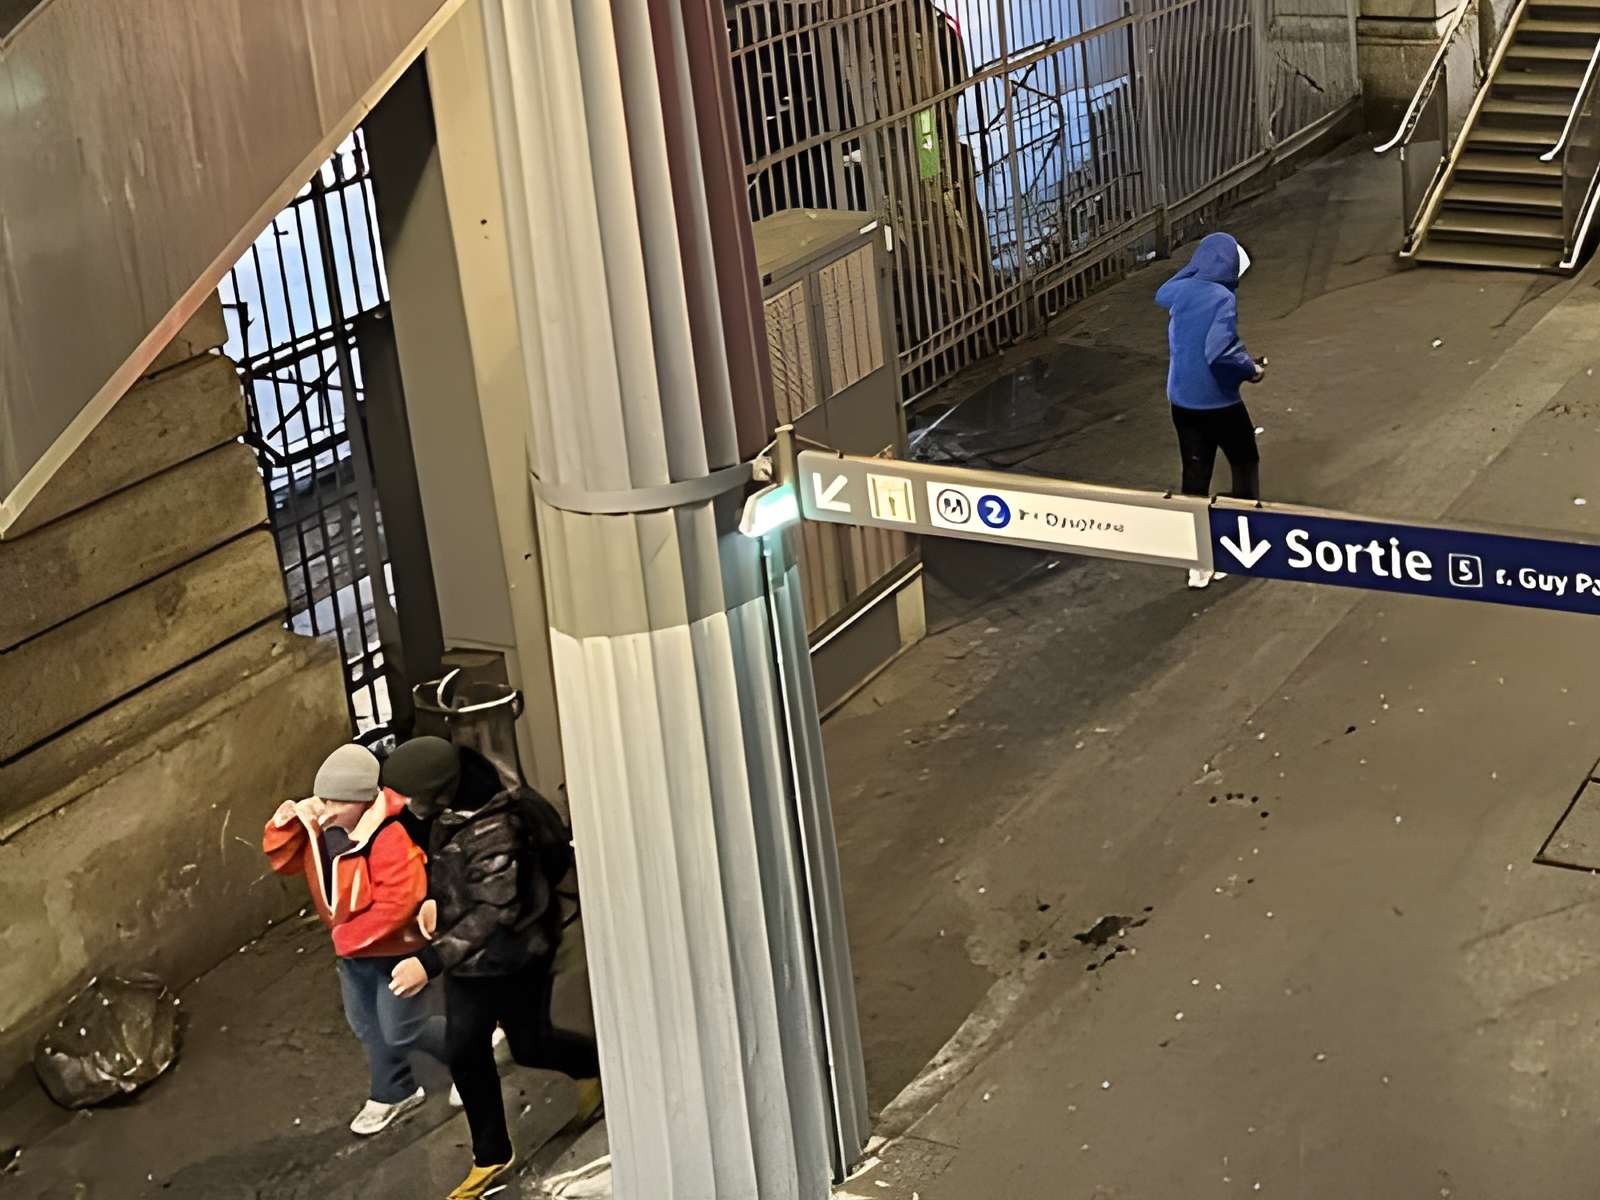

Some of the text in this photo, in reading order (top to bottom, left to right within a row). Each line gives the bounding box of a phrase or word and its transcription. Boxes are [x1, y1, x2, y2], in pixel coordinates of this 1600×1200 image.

[985, 500, 1006, 524] 2
[1285, 528, 1433, 582] Sortie
[1519, 568, 1569, 596] Guy
